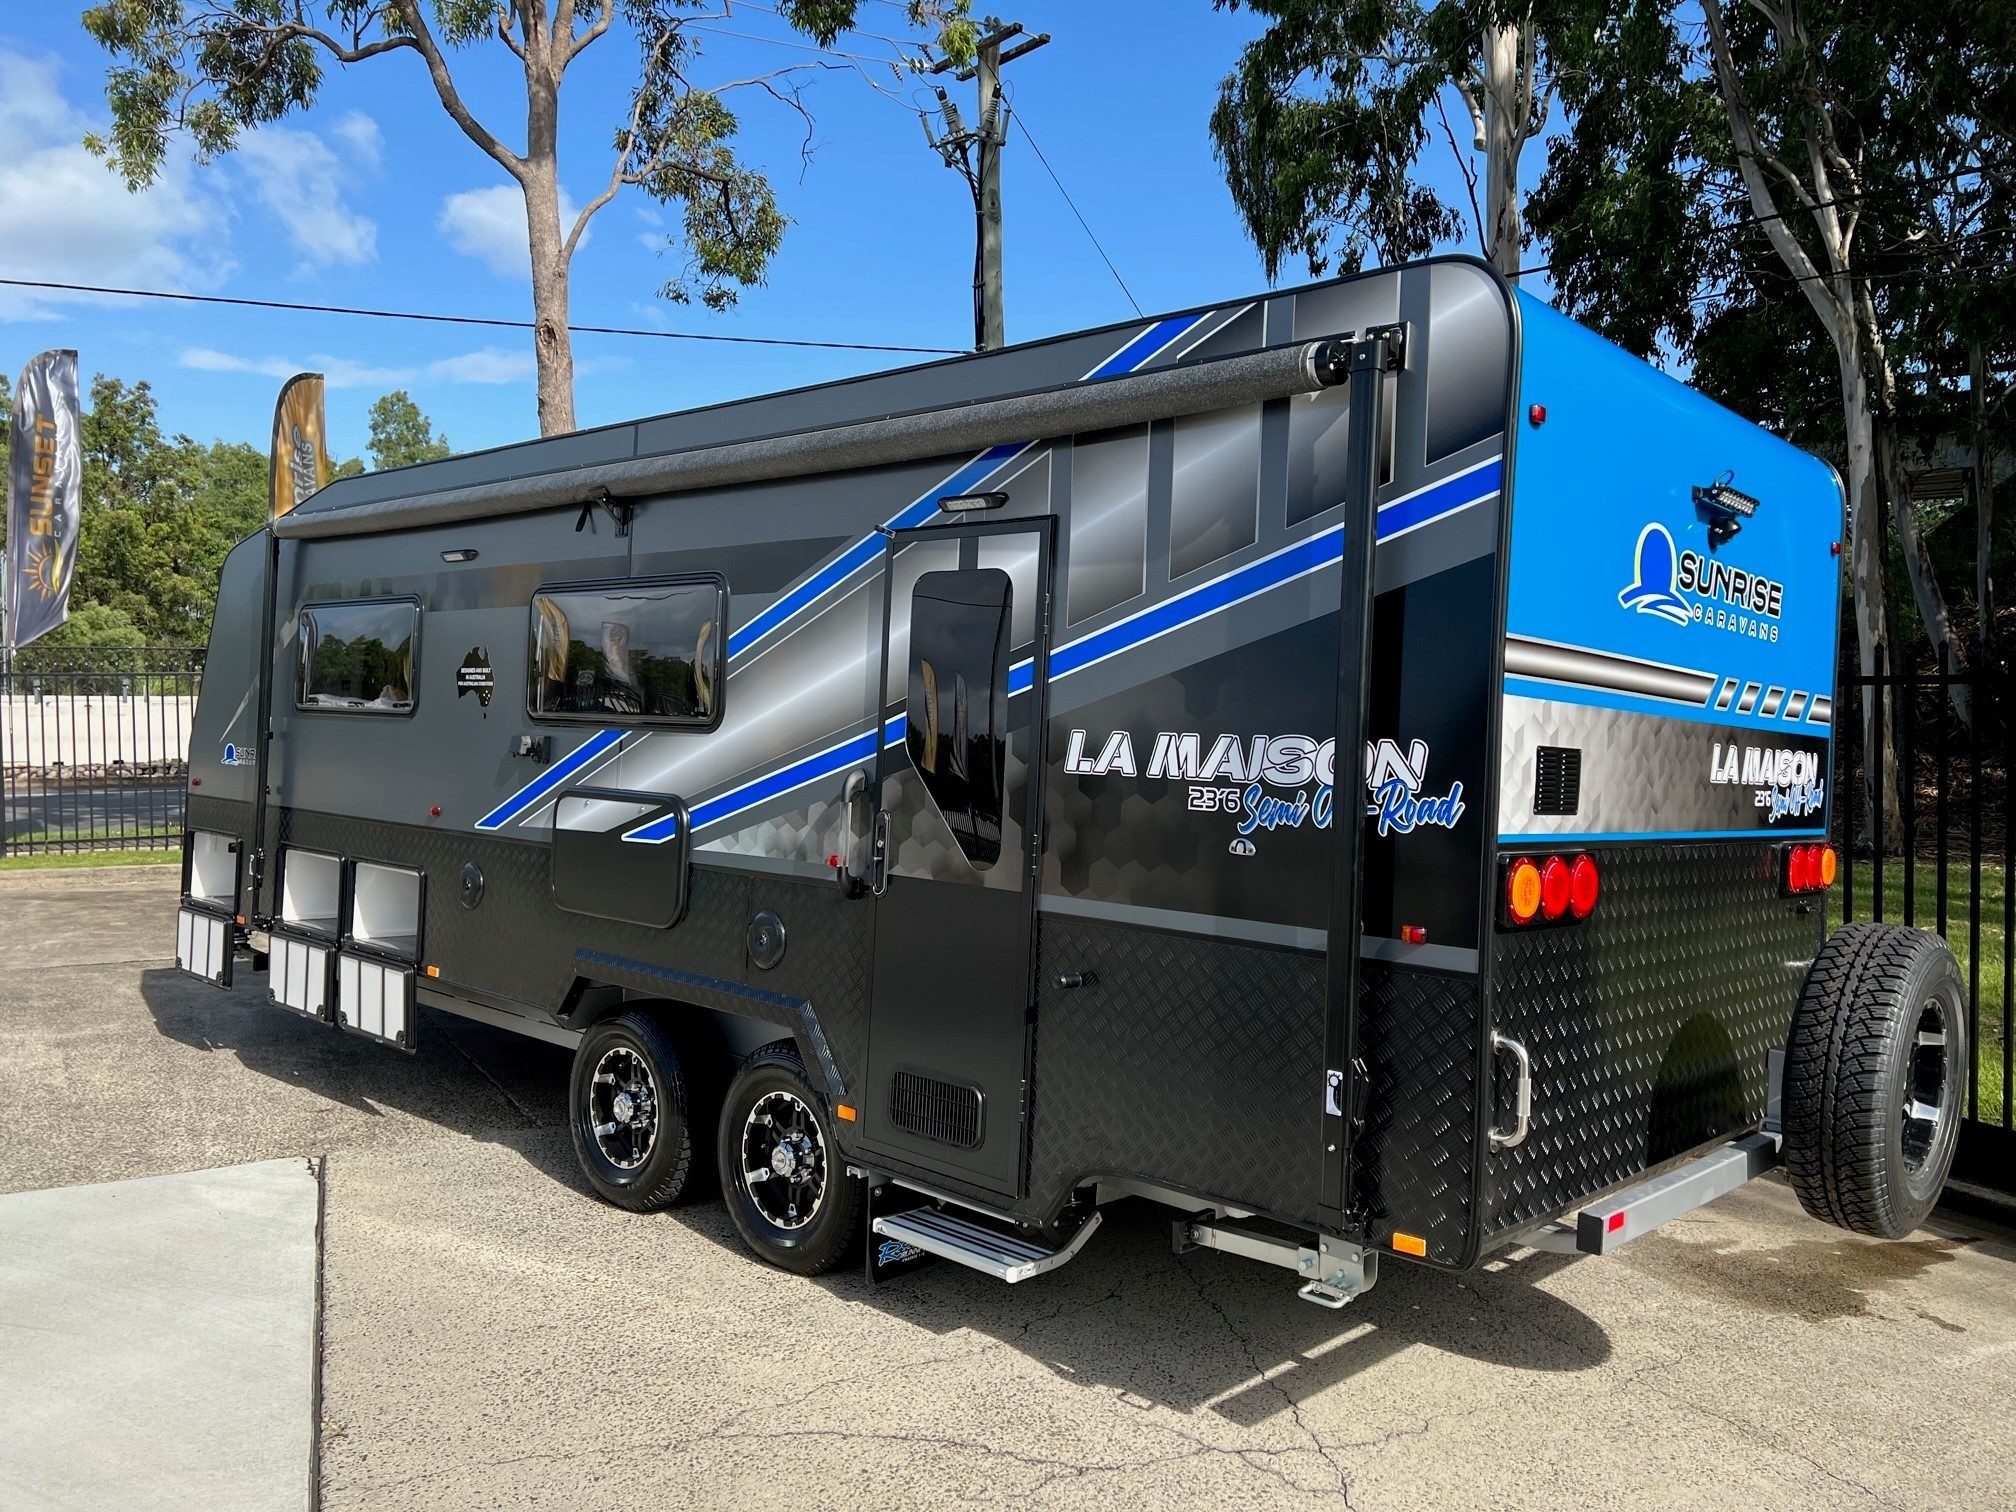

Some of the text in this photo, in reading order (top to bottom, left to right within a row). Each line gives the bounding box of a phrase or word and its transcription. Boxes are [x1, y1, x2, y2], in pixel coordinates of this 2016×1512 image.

[29, 413, 58, 537] SUNSET
[290, 424, 307, 505] nrise
[300, 441, 317, 497] AVANS
[1677, 550, 1784, 619] SUNRISE
[1693, 604, 1780, 643] CARAVANS
[1064, 730, 1137, 776] LA
[1710, 743, 1818, 787] LA MAISON
[1237, 783, 1308, 834] Semi
